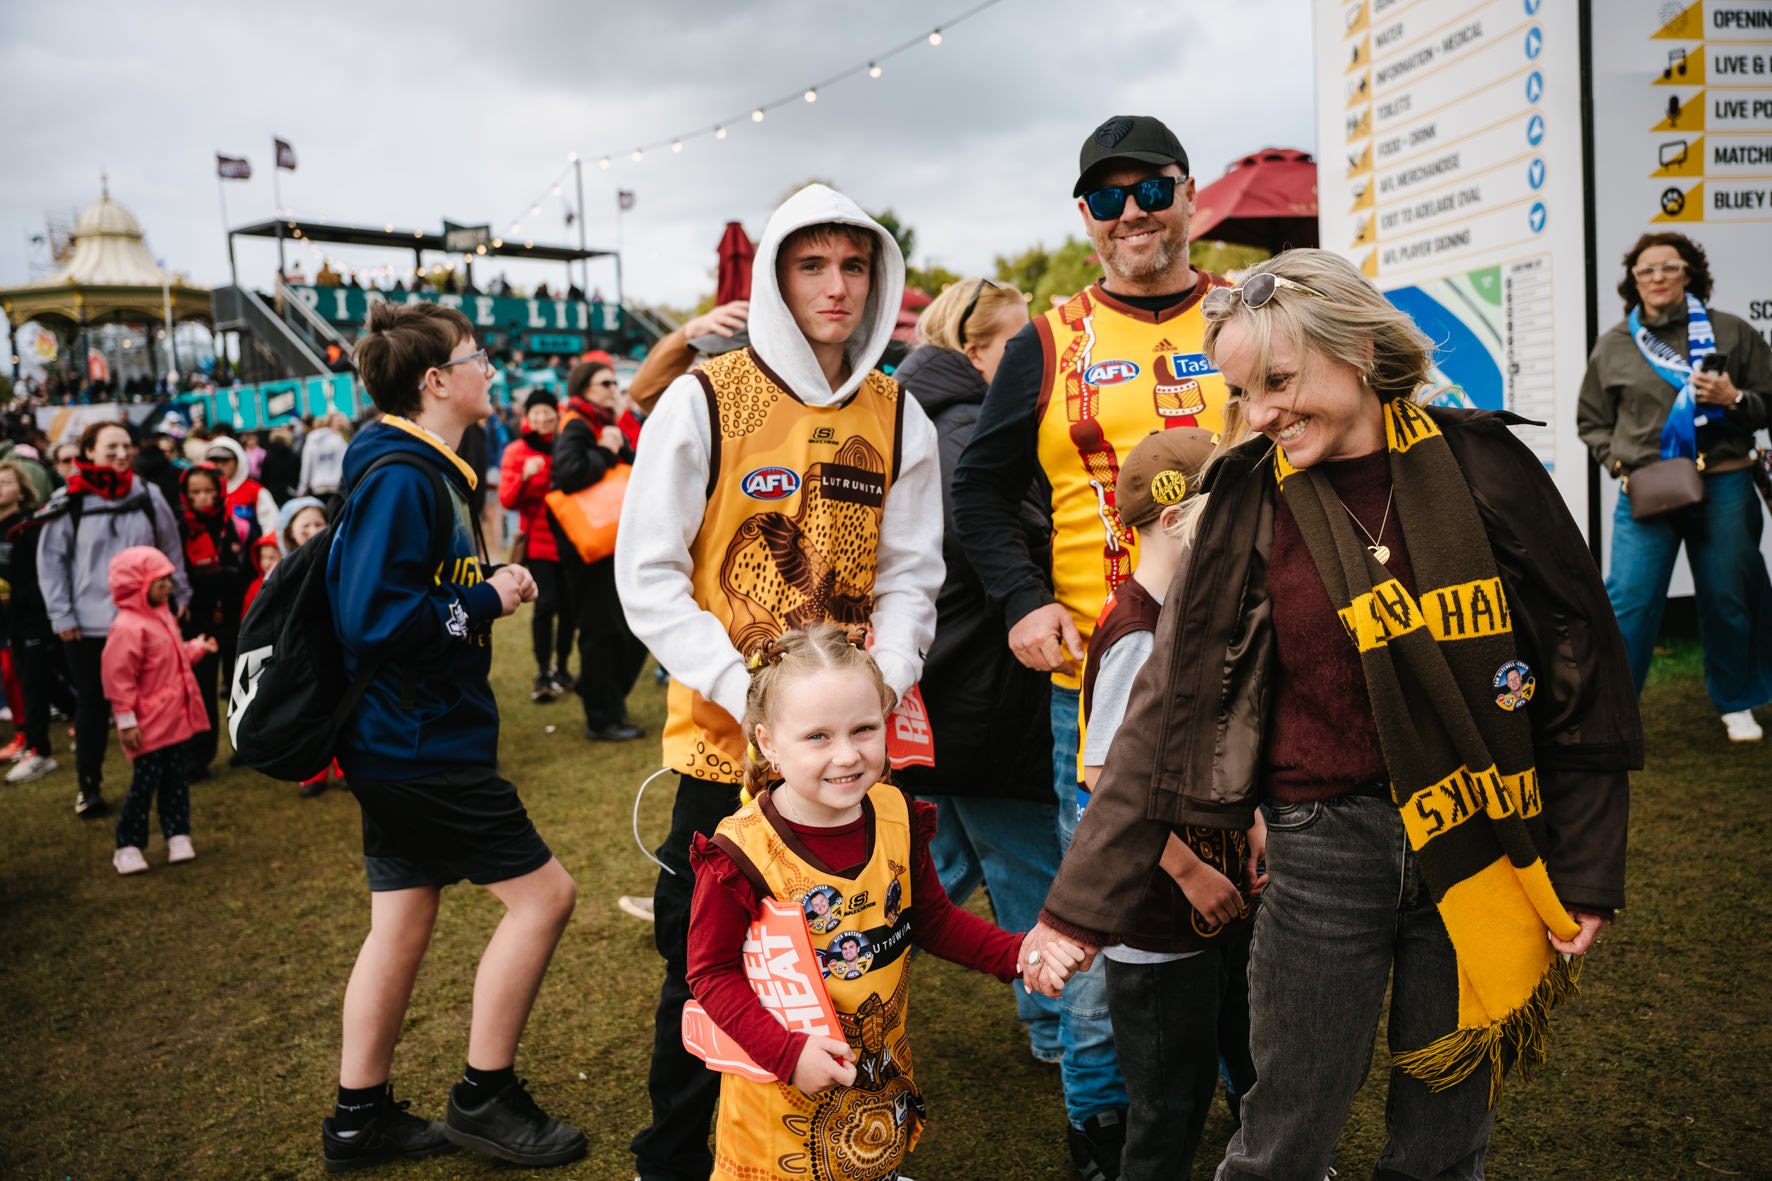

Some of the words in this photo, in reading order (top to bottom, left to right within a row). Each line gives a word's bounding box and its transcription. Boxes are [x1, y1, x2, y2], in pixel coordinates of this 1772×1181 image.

[1715, 55, 1748, 75] LIVE
[1752, 55, 1765, 75] &
[1715, 100, 1748, 119] LIVE
[1409, 123, 1437, 147] DRINK
[1714, 146, 1772, 165] MATCH
[1714, 190, 1765, 210] BLUEY
[1089, 366, 1136, 383] AFL
[747, 472, 796, 493] AFL
[760, 925, 831, 1036] HEAT
